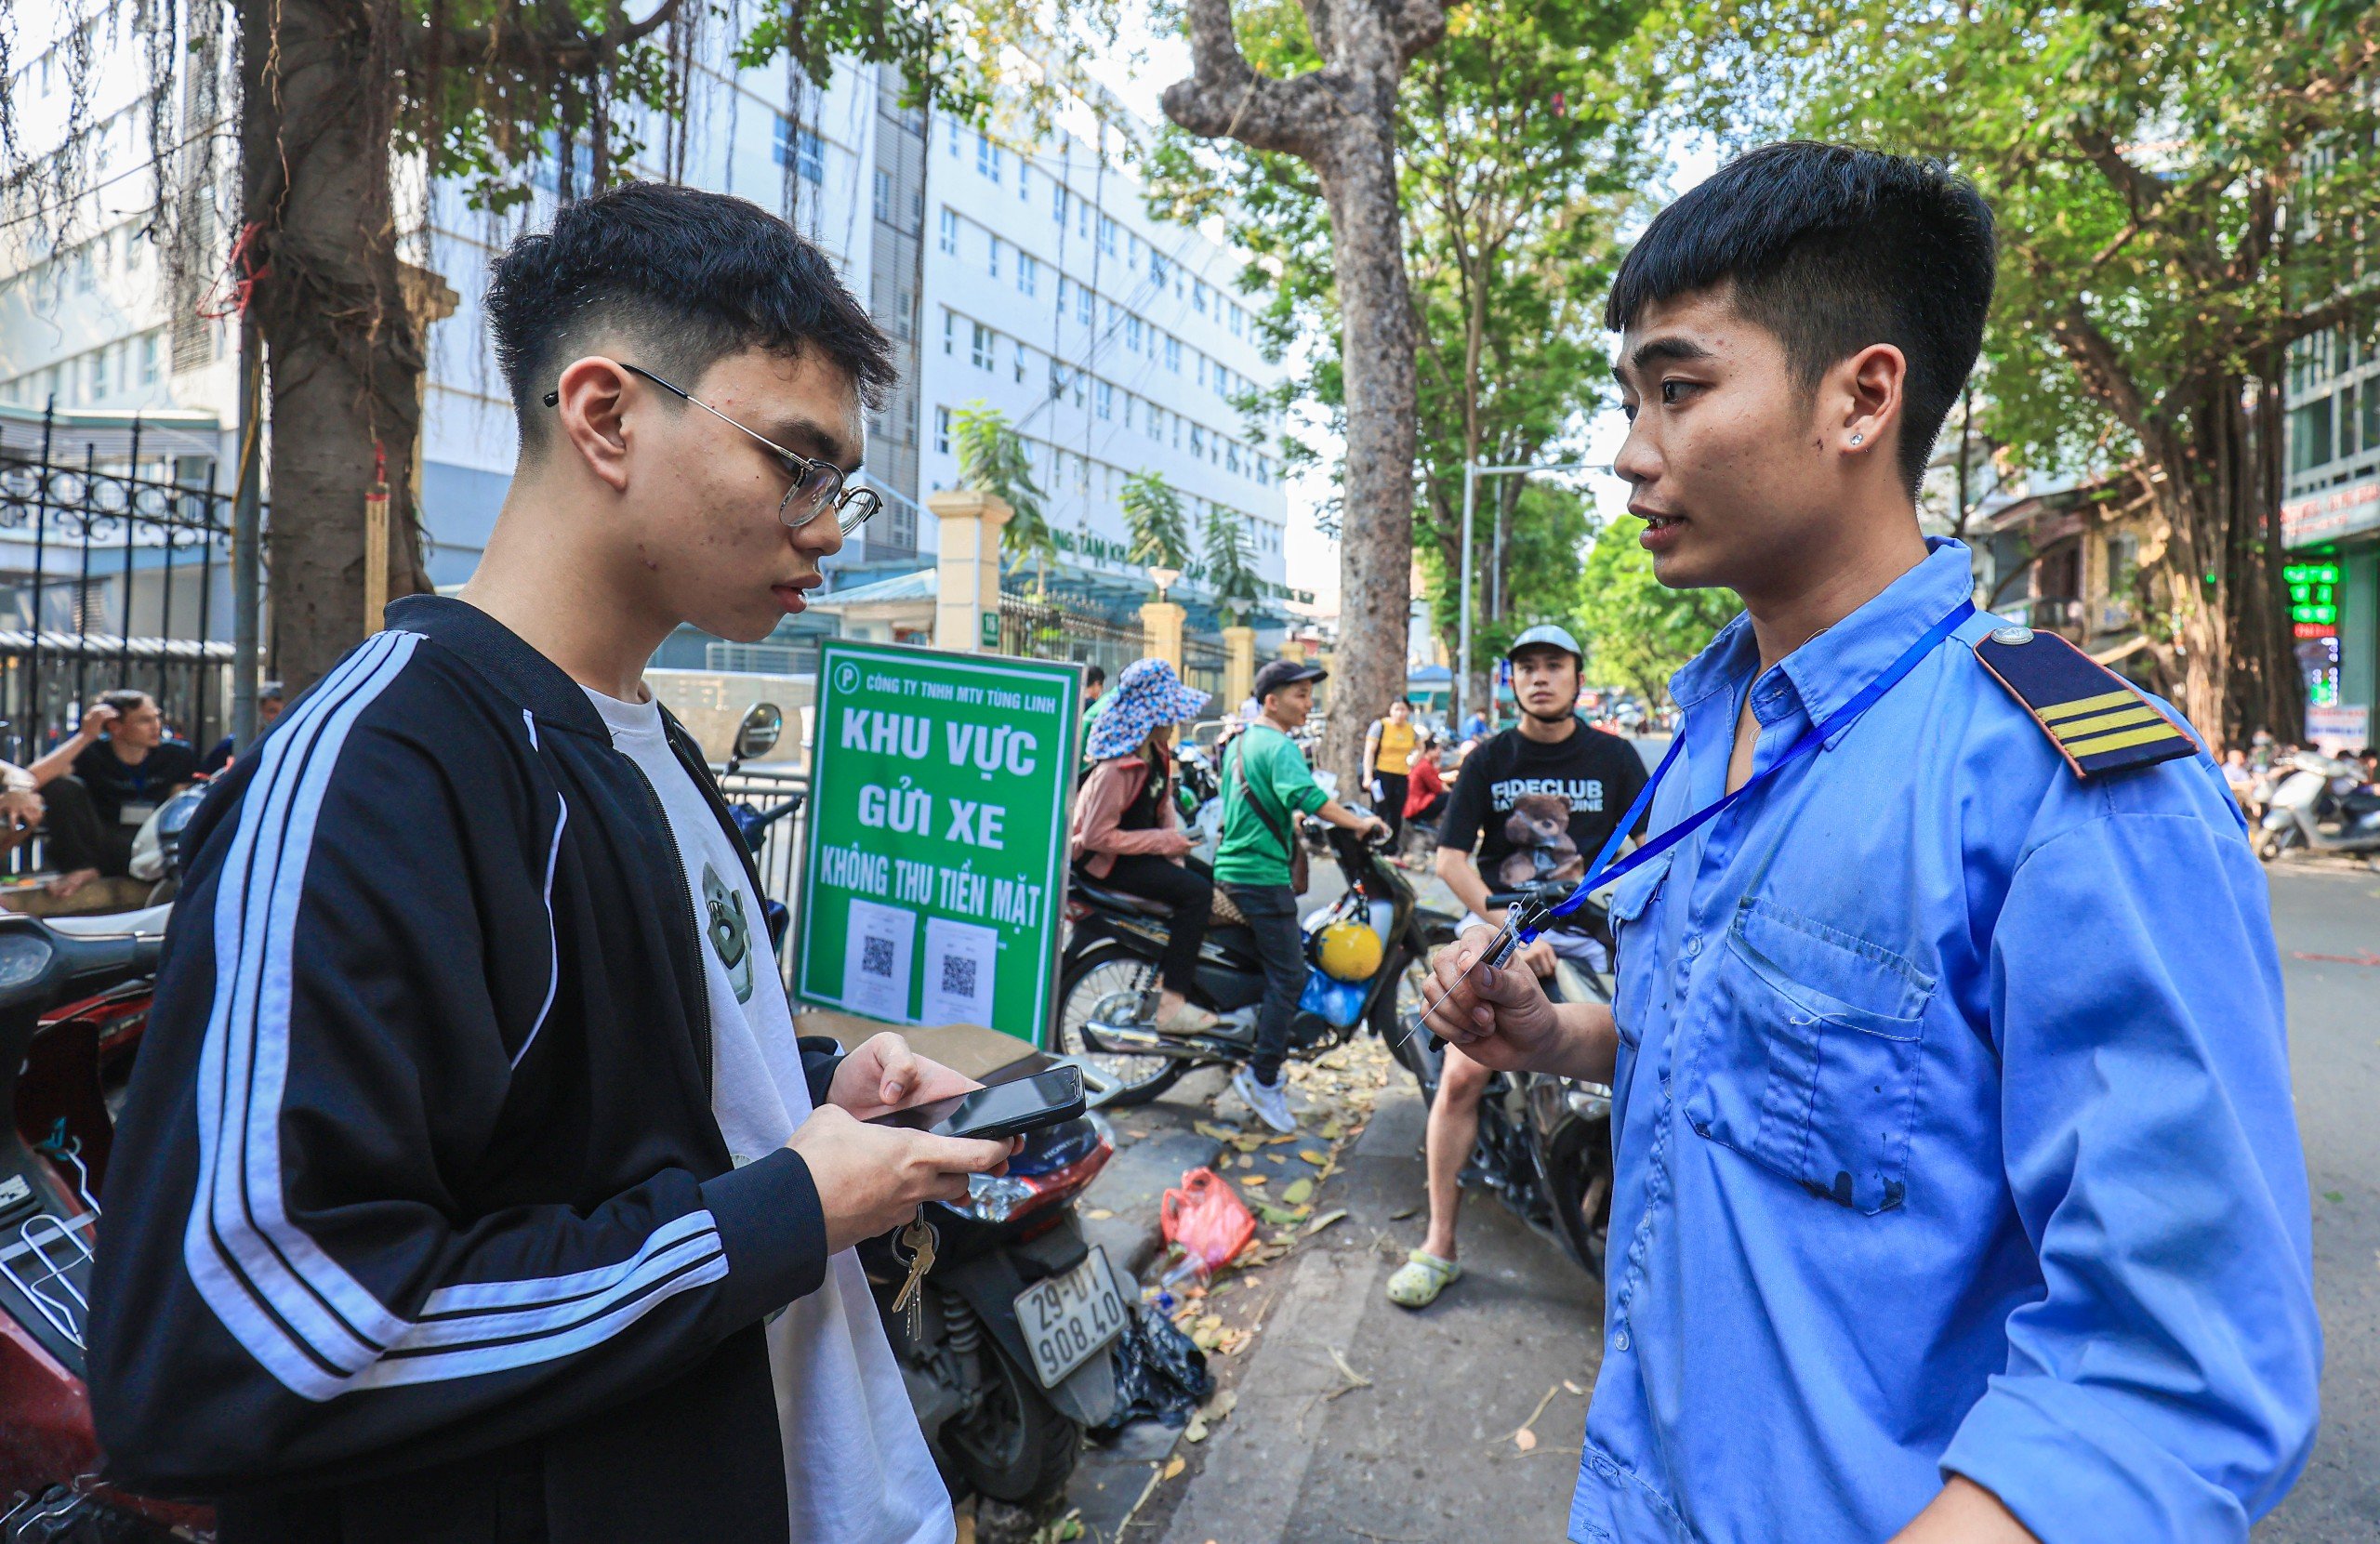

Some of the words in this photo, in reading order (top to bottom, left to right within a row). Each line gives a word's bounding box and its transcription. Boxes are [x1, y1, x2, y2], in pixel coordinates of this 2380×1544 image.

[866, 672, 900, 694] CÔNG
[903, 679, 918, 696] TY
[920, 681, 954, 702] TNHH
[956, 686, 984, 705] MTV
[1024, 694, 1056, 715] LINH
[840, 706, 931, 760] KHU
[945, 720, 1038, 782] VỰC
[858, 775, 932, 838] GỬI
[945, 798, 1006, 851] XE
[820, 841, 889, 898] KHÔNG
[894, 859, 934, 906] THU
[990, 873, 1041, 935] MẶT
[1038, 1291, 1120, 1375] 908.40
